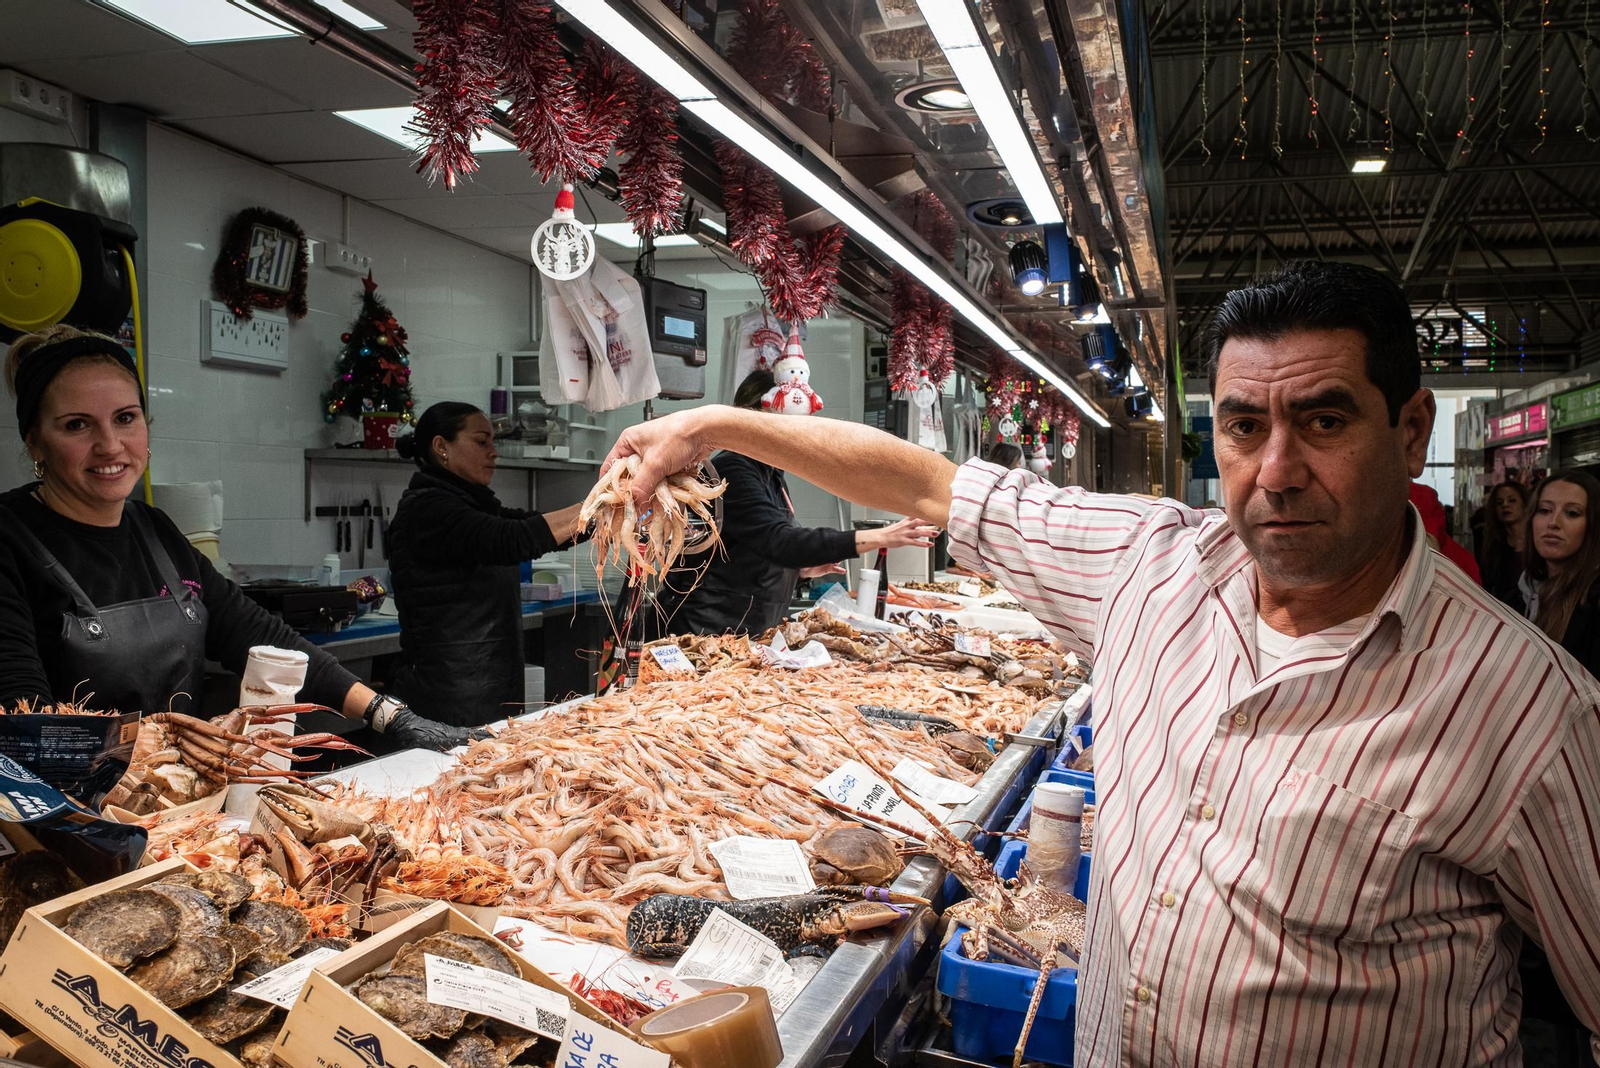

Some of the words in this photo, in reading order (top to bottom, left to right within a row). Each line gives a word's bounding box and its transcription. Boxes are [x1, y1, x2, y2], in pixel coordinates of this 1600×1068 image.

[44, 1006, 84, 1039] (Depuradora):
[65, 1014, 83, 1032] Vento,
[91, 1034, 110, 1051] Apdo.
[571, 1029, 594, 1052] DE
